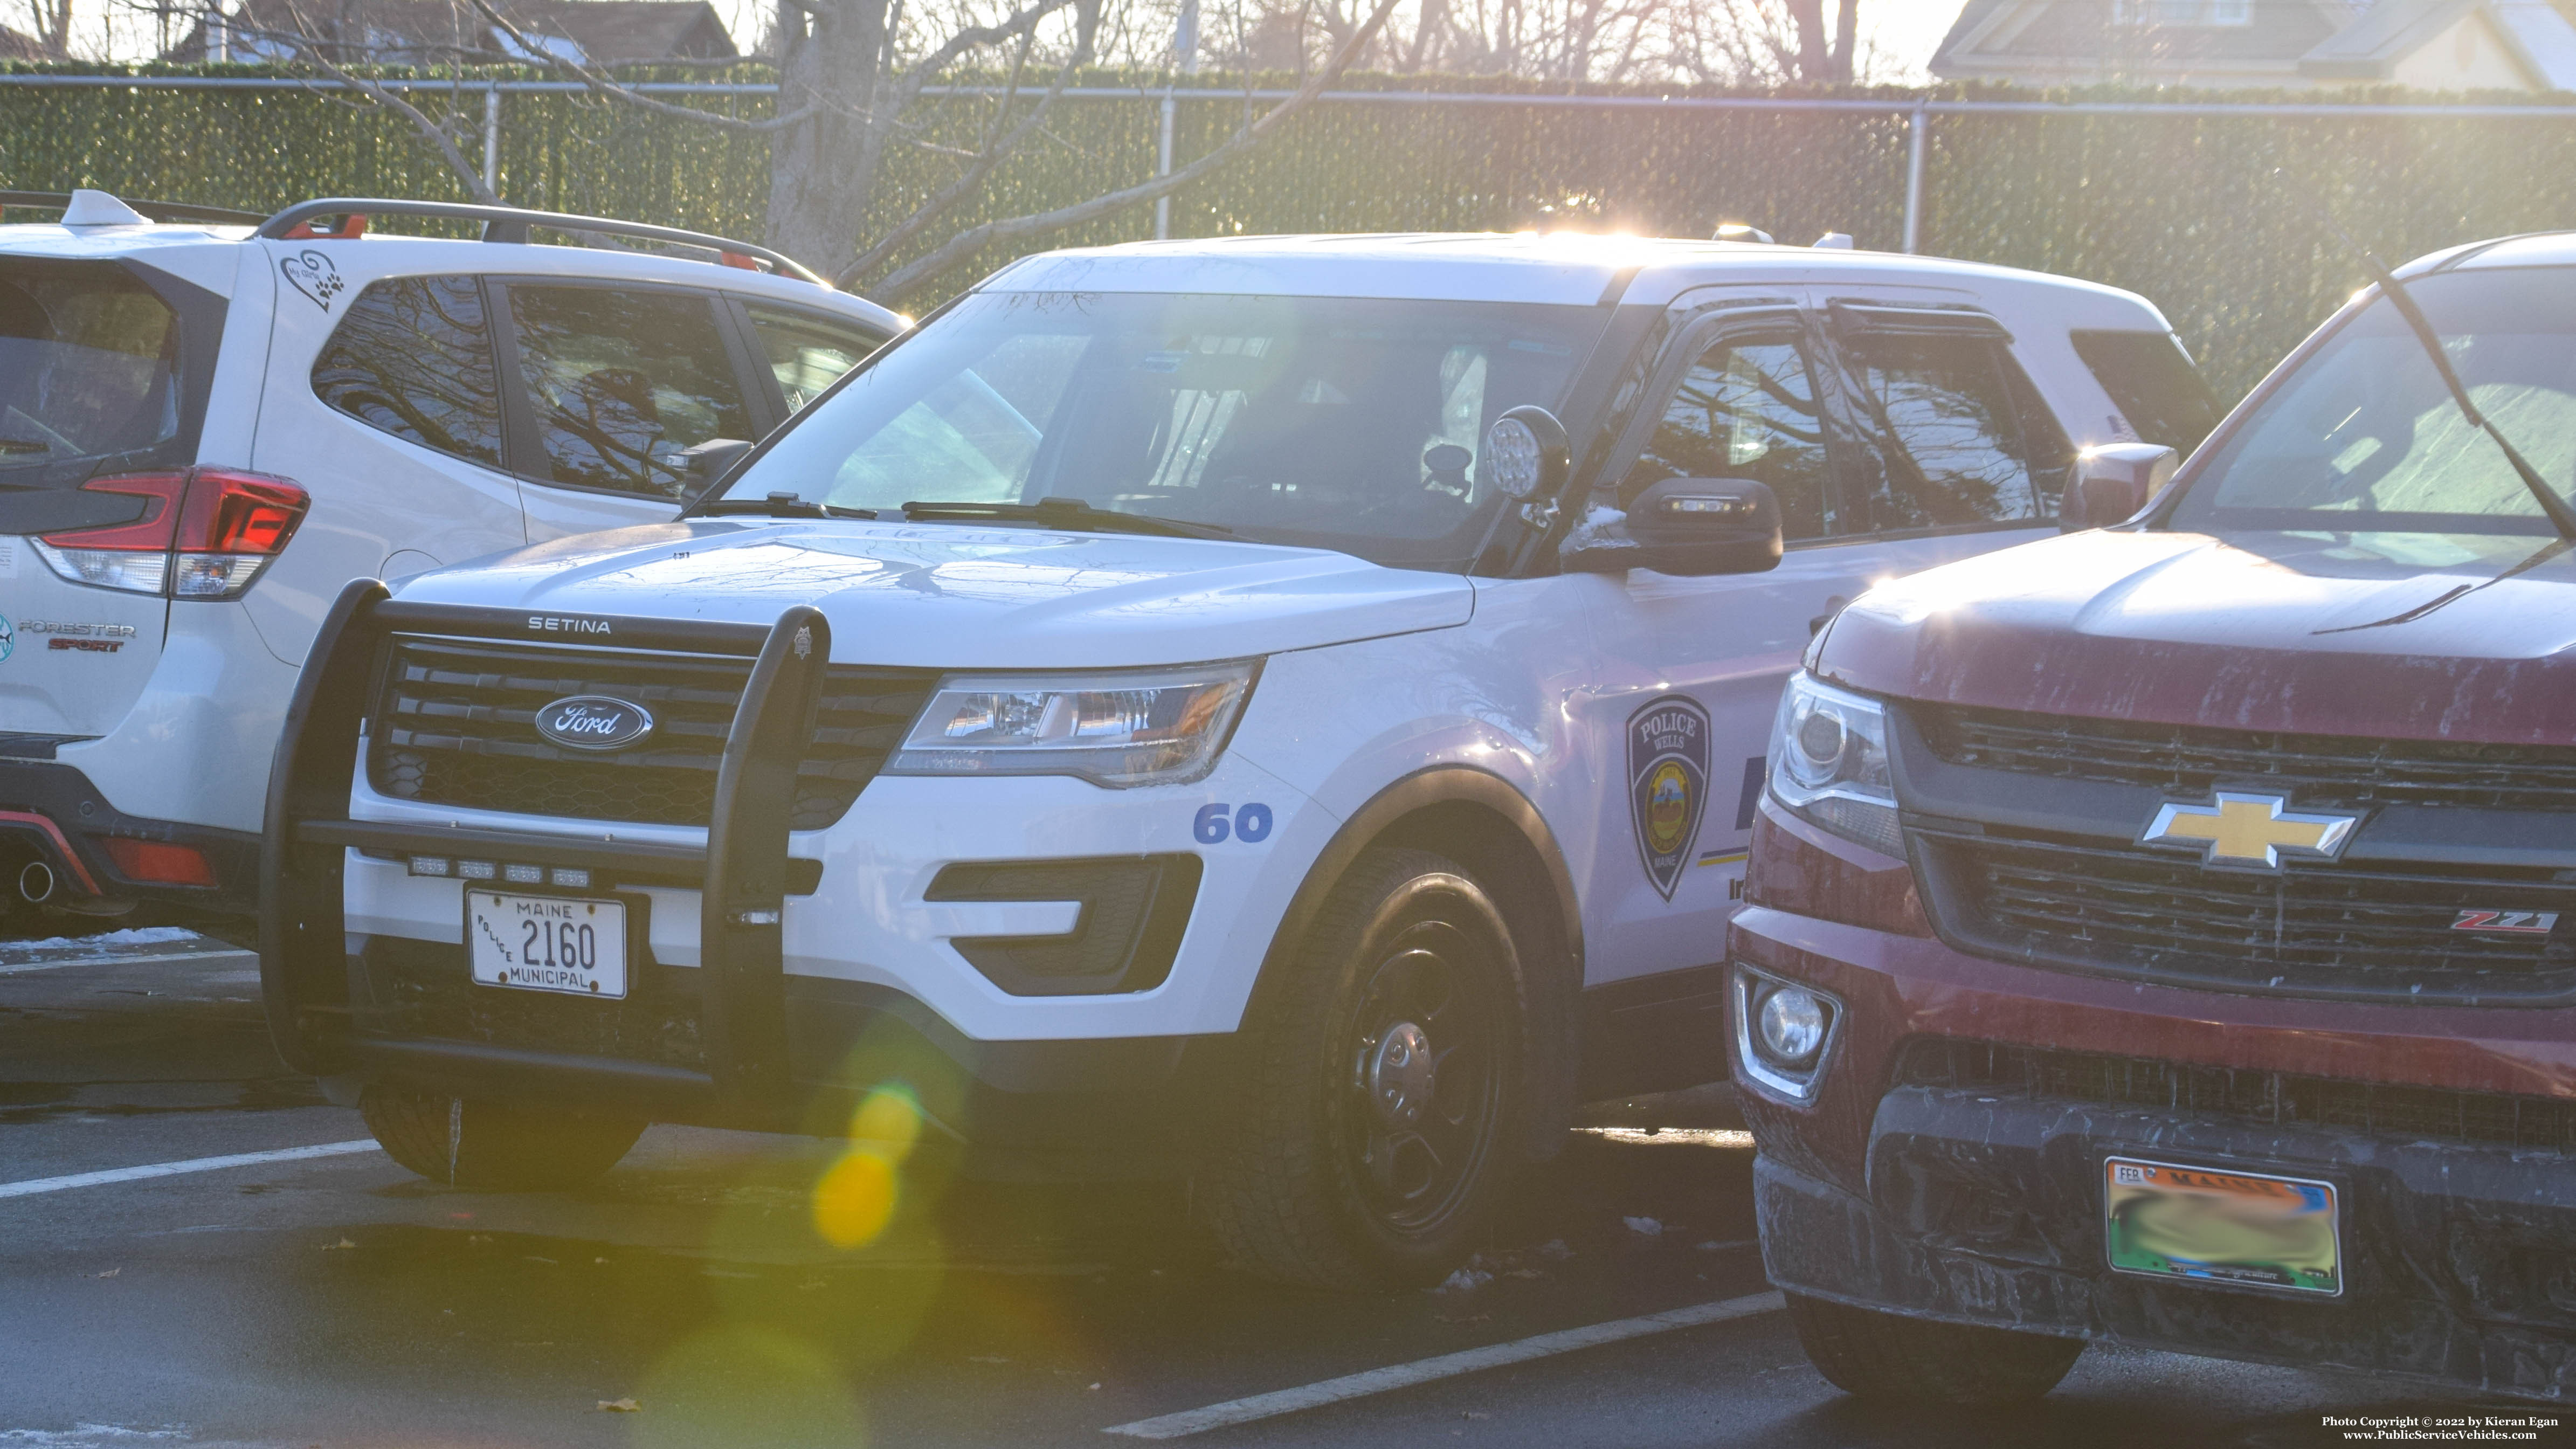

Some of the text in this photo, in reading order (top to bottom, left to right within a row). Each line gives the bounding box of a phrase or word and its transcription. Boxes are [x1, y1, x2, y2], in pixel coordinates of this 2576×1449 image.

[288, 267, 300, 278] My
[18, 620, 137, 638] FORESTER
[528, 617, 611, 635] SETINA
[48, 638, 125, 653] SPORT
[555, 702, 621, 735] Ford
[1640, 713, 1696, 743] POLICE
[1654, 735, 1684, 751] WELLS
[1193, 802, 1274, 845] 60
[1654, 855, 1677, 867] MAINE
[517, 902, 573, 919] MAINE
[2450, 910, 2559, 933] Z71
[478, 915, 512, 962] POLICE
[522, 920, 596, 970] 2160
[510, 968, 588, 988] MUNICIPAL
